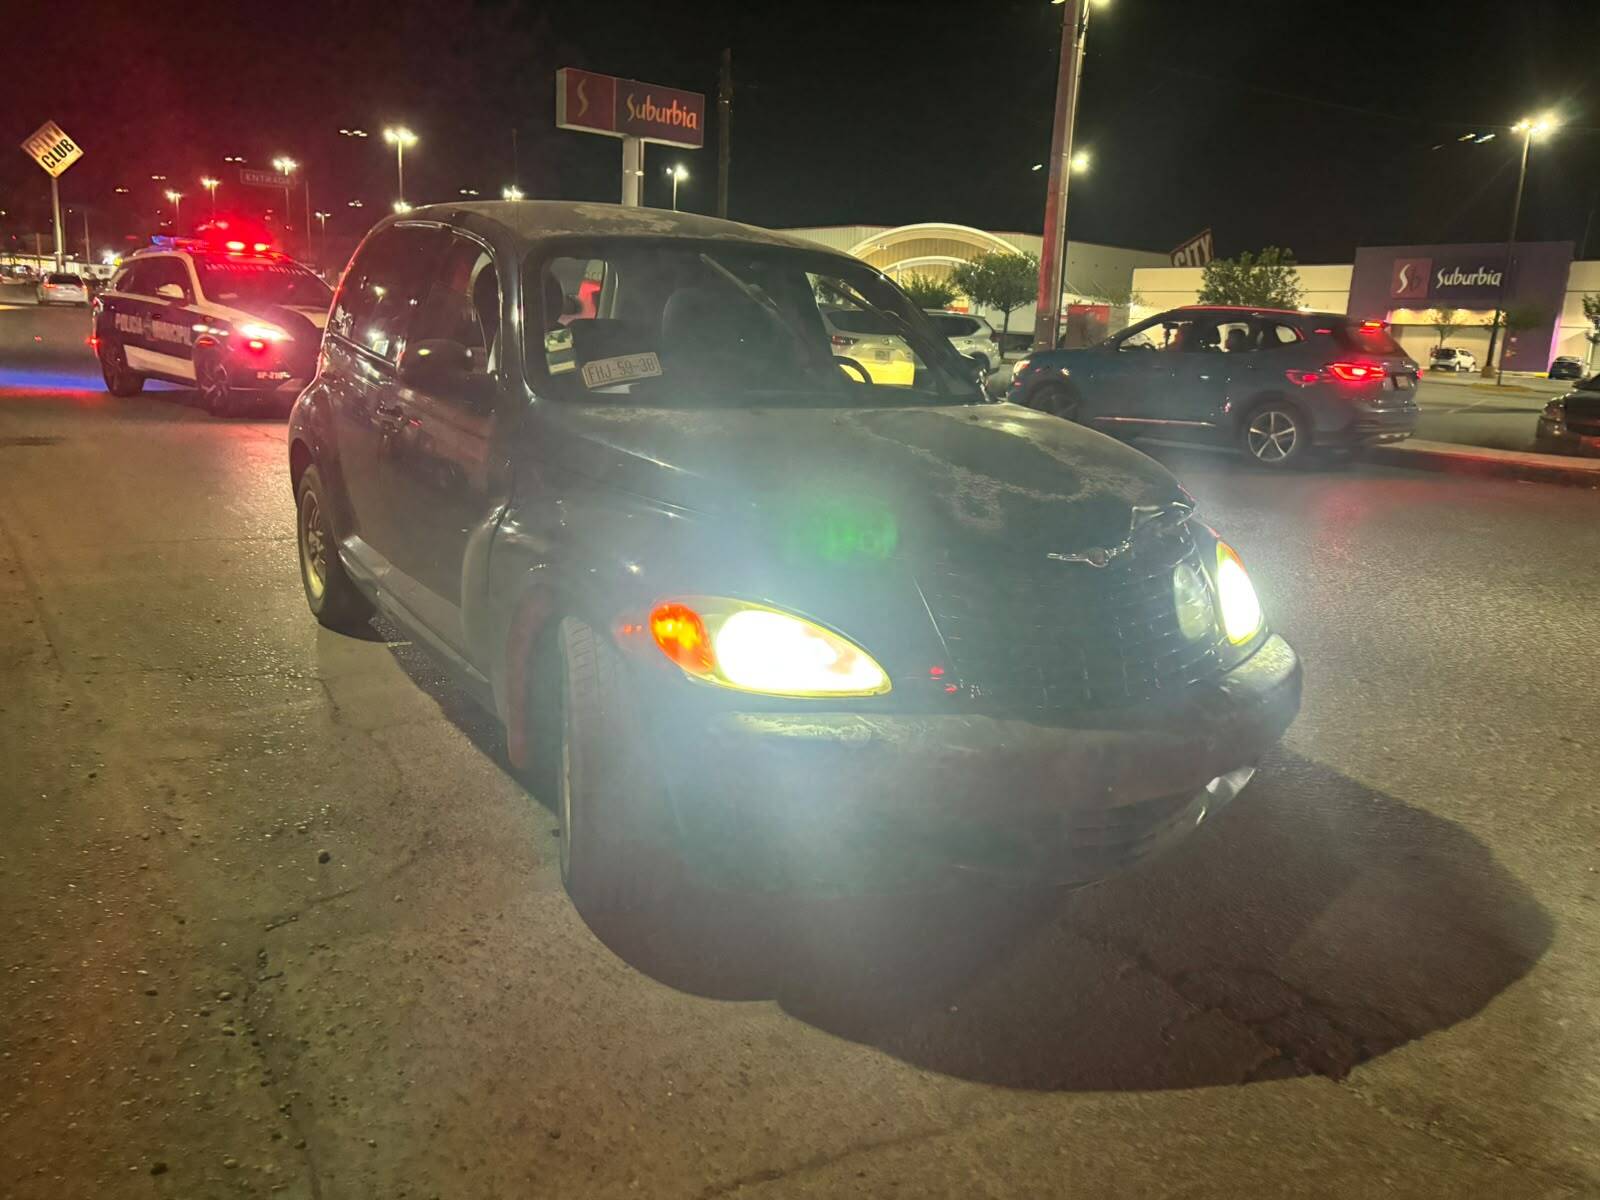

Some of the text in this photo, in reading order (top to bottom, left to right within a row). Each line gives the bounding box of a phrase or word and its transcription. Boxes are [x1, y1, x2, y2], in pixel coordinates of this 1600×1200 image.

[626, 93, 697, 130] Suburbia
[41, 138, 75, 169] CLUB
[1435, 266, 1503, 289] Suburbia
